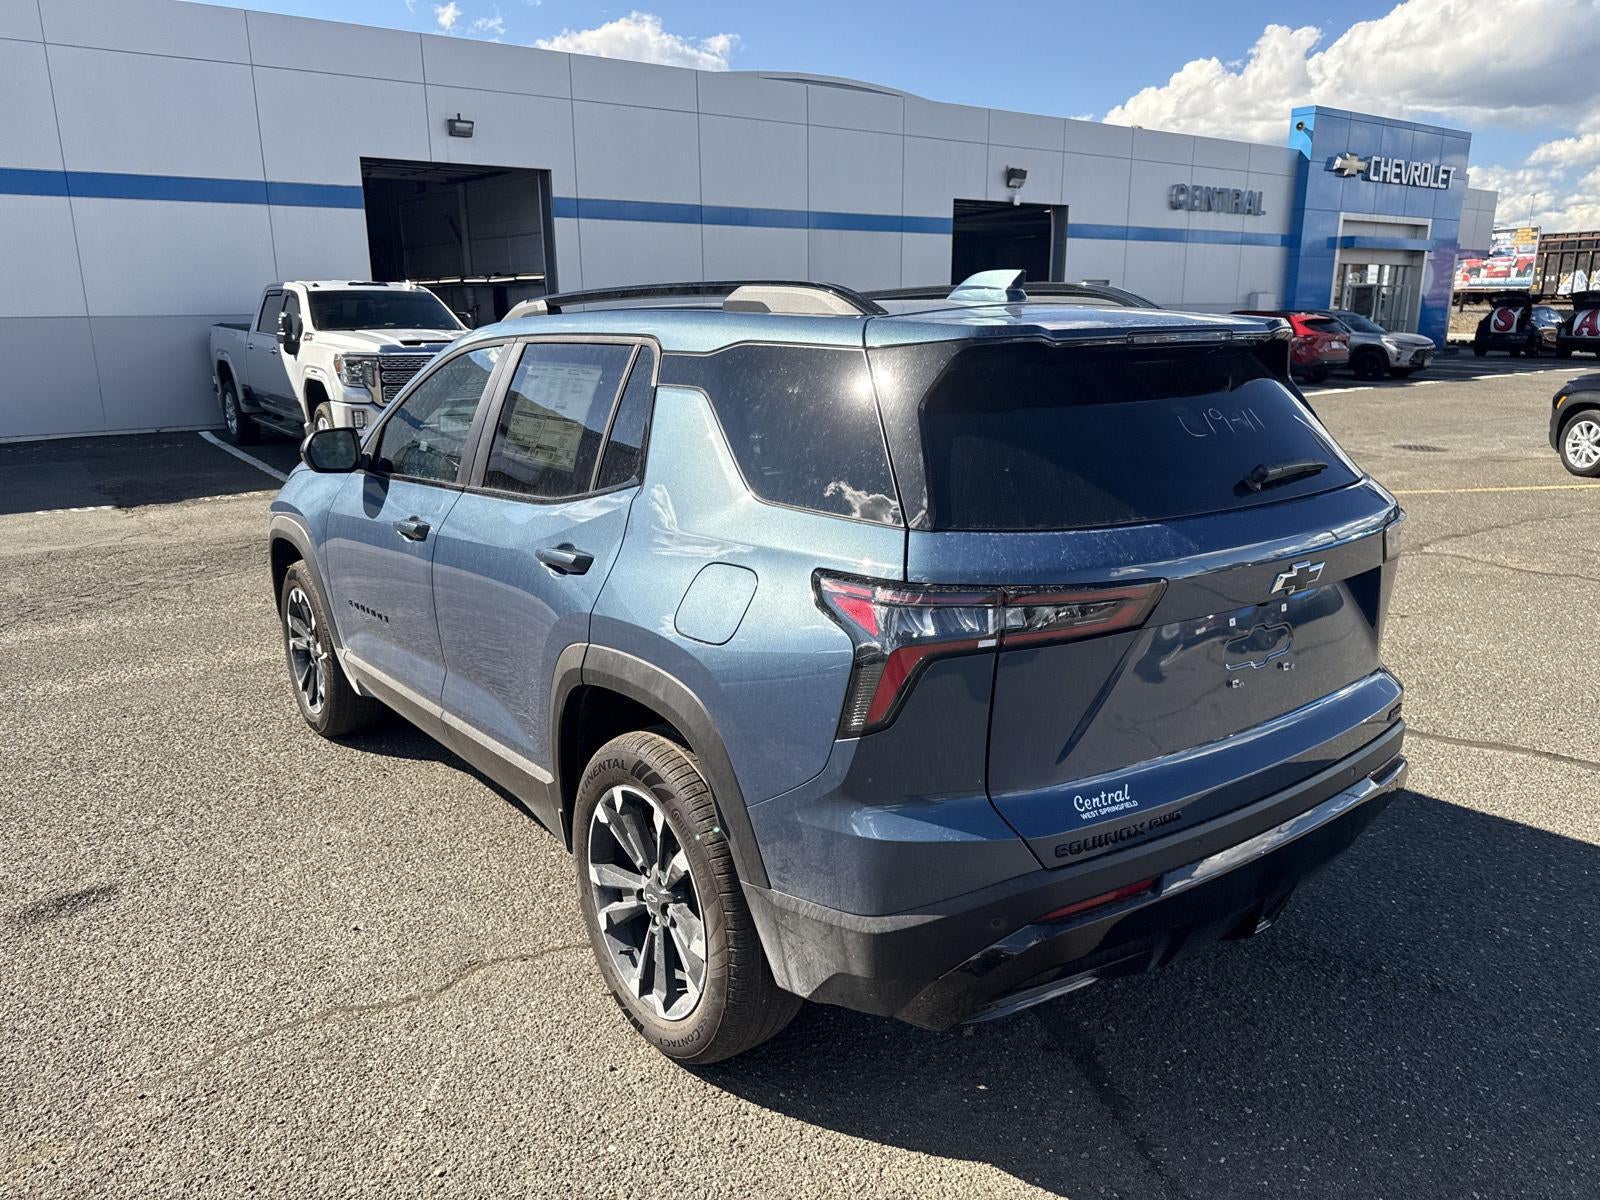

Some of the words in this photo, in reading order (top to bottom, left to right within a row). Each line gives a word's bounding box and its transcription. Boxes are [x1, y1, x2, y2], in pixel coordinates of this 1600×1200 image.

[1369, 155, 1457, 190] CHEVROLET
[1168, 183, 1266, 216] CENTRAL
[1494, 308, 1516, 332] S
[577, 758, 629, 808] NTINENTAL
[1073, 783, 1130, 812] Central
[1080, 809, 1099, 821] WEST
[1099, 800, 1139, 816] SPRINGFIELD
[1054, 821, 1146, 859] EQUINOX
